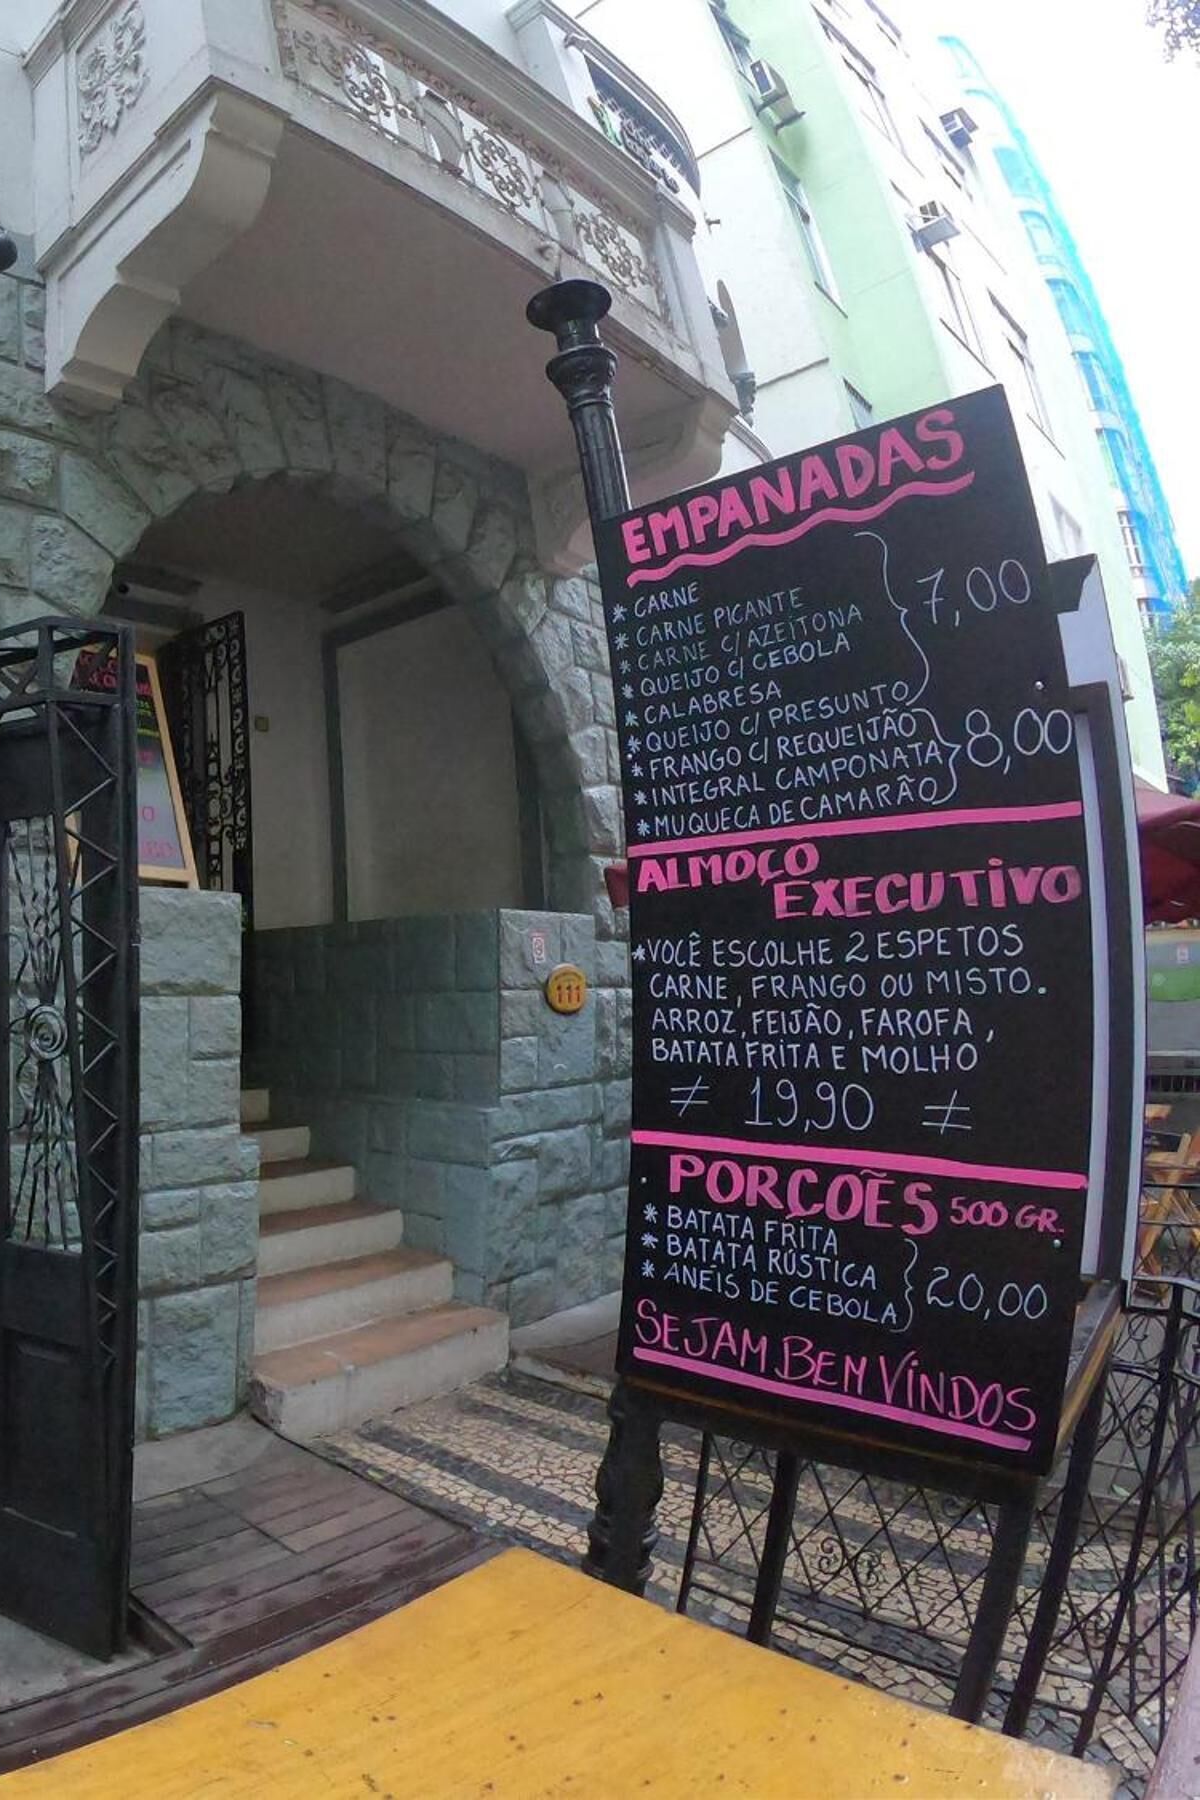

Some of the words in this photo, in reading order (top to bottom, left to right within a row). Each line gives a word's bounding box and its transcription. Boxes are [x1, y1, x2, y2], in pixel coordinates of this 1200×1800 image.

[621, 409, 966, 564] EMPANADAS
[634, 582, 700, 617] CARNE
[636, 613, 706, 647] CARNE
[713, 587, 804, 629] PICANTE
[916, 558, 1031, 628] 7,00
[638, 640, 712, 671] CARNE
[640, 665, 720, 697] QUEIJO
[753, 632, 851, 671] CEBOLA
[644, 680, 782, 725] CALABRESA
[646, 719, 730, 753] QUEIJO
[769, 681, 909, 729] PRESUNTO
[650, 747, 742, 780] FRANGO
[777, 707, 916, 760] REQUEIJÃO
[965, 708, 1073, 775] 8,00
[651, 771, 766, 807] INTEGRAL
[775, 740, 943, 790] CAMPONATA
[655, 804, 761, 837] MUQUECA
[768, 800, 795, 825] DE
[800, 774, 938, 821] CAMARÃO
[636, 842, 820, 893] ALMOÇO
[647, 932, 701, 968] VOCÊ
[712, 938, 834, 967] ESCOLHE
[845, 931, 870, 963] 2
[878, 924, 1024, 958] ESPETOS
[751, 974, 866, 999] FRANGO
[881, 973, 913, 996] OU
[651, 1038, 739, 1068] BATATA
[833, 1045, 846, 1070] E
[862, 1042, 978, 1075] MOLHO
[744, 1075, 875, 1134] 19,90
[667, 1205, 755, 1240] BATATA
[668, 1154, 939, 1235] PORÇÕES
[949, 1197, 1008, 1227] 500
[666, 1234, 756, 1272] BATATA
[768, 1249, 877, 1290] RÚSTICA
[664, 1262, 740, 1299] ANÉIS
[751, 1279, 779, 1304] DE
[789, 1285, 898, 1324] CEBOLA
[926, 1265, 1048, 1321] 20,00
[635, 1298, 768, 1374] SEJAM
